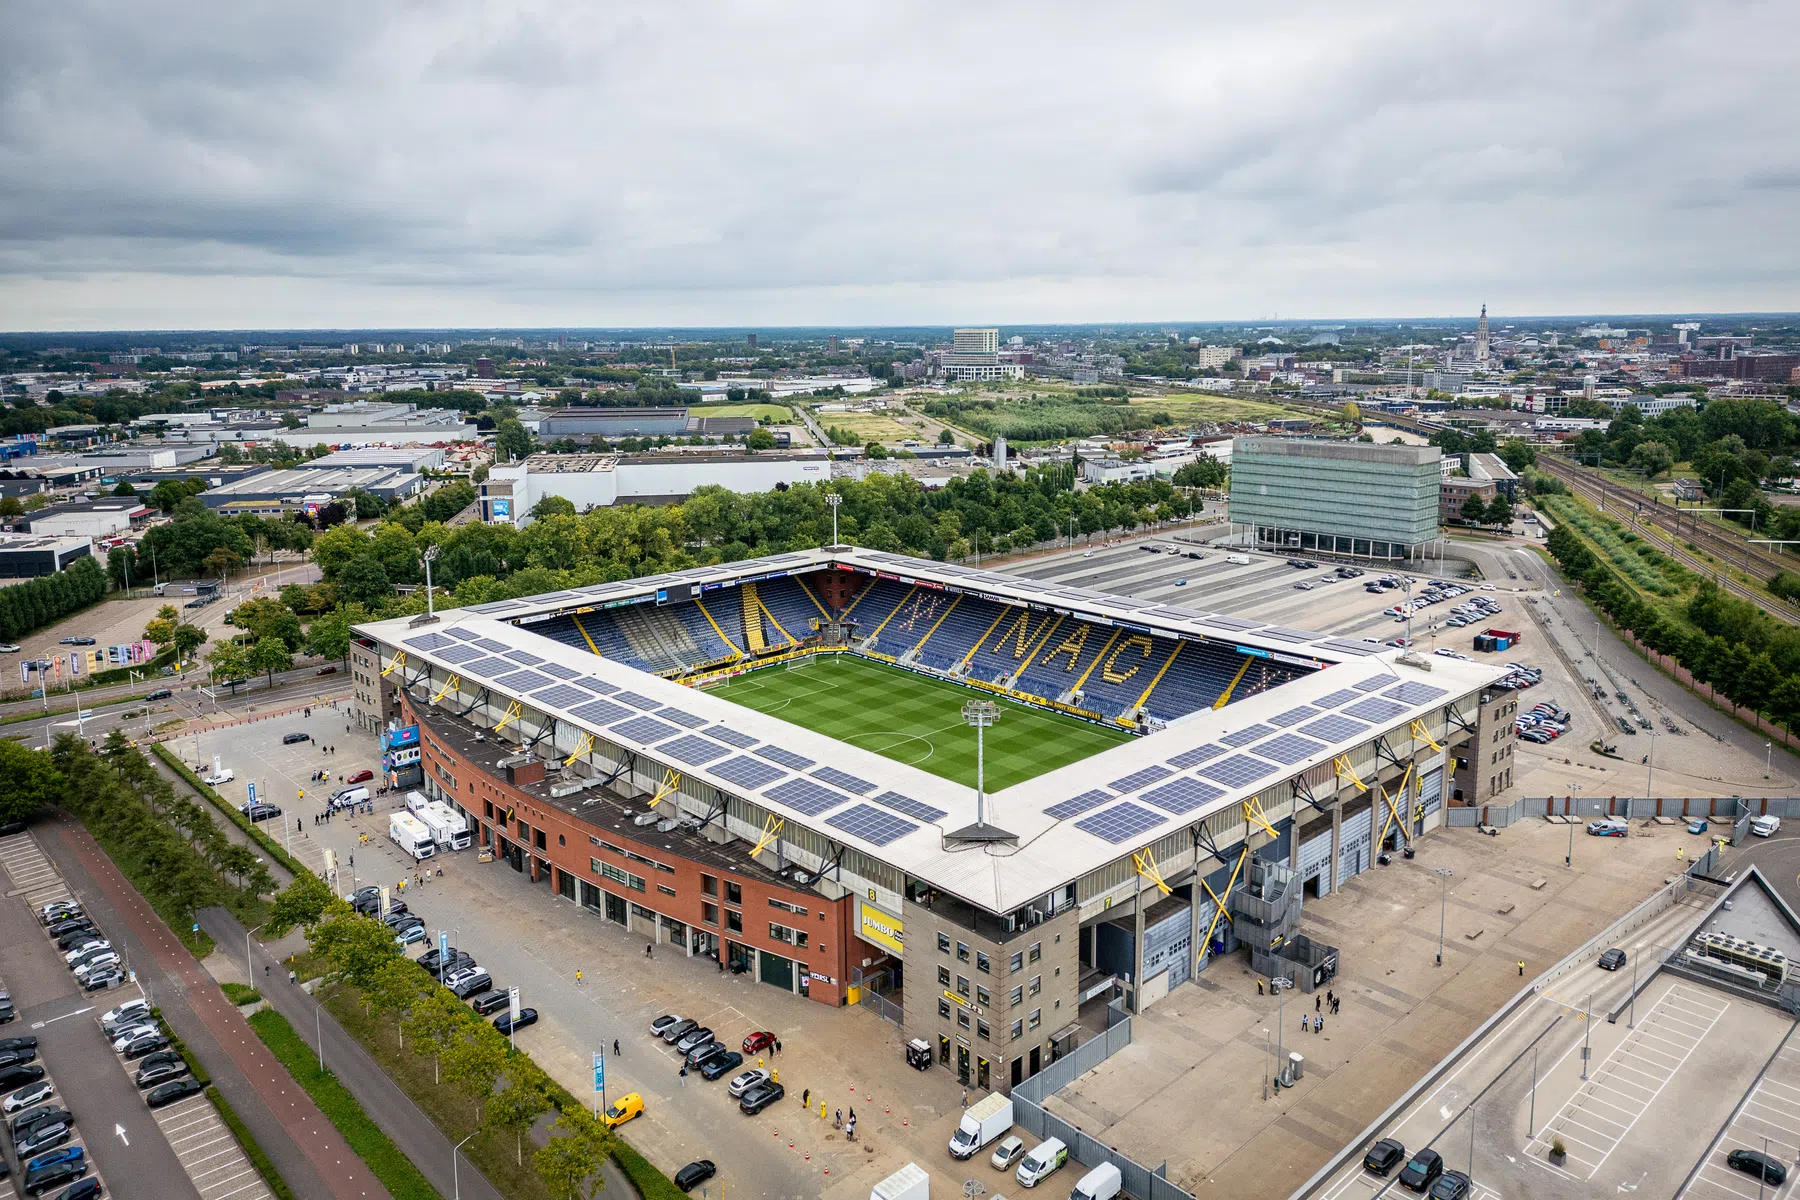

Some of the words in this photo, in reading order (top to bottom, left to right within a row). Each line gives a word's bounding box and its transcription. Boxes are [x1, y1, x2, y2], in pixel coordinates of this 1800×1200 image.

[993, 611, 1152, 683] NAC
[869, 889, 876, 901] 8
[1105, 897, 1111, 910] 7
[863, 916, 894, 938] JUMBO
